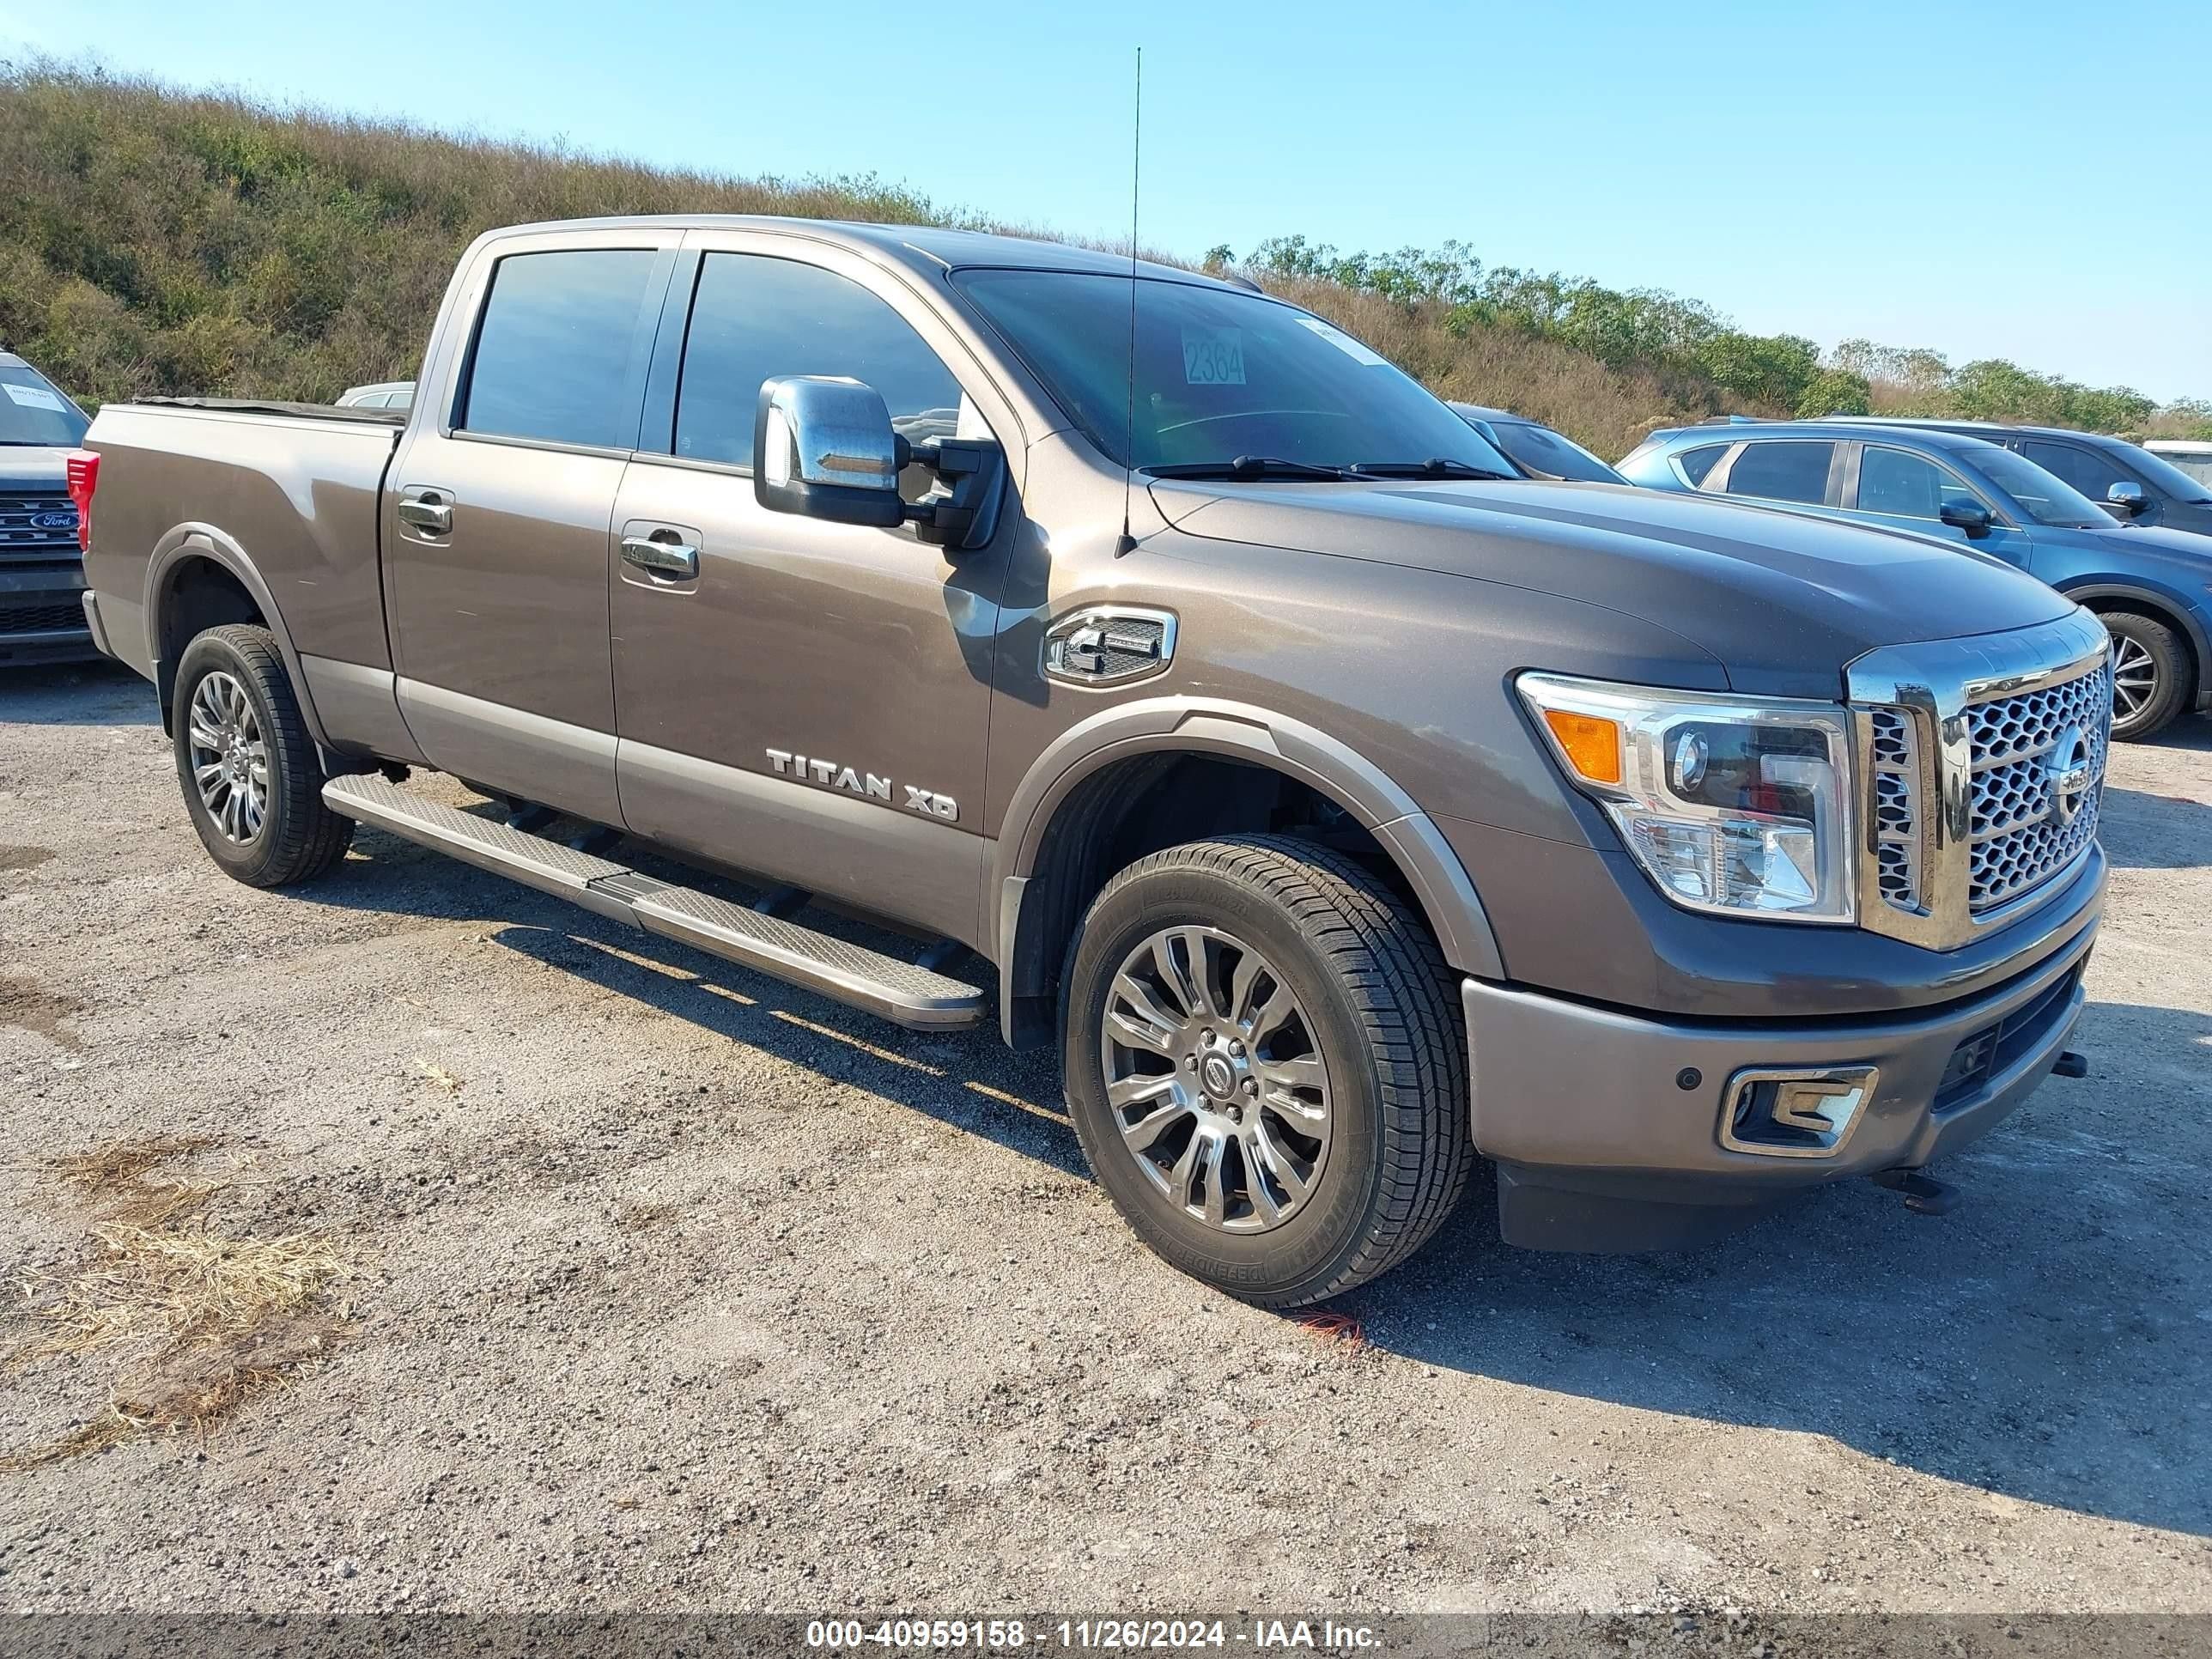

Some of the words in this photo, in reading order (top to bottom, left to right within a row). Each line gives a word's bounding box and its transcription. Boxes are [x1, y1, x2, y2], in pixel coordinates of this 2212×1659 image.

[1185, 342, 1243, 382] 2364
[43, 514, 70, 526] Ford
[765, 746, 894, 802] TITAN
[904, 784, 961, 823] XD
